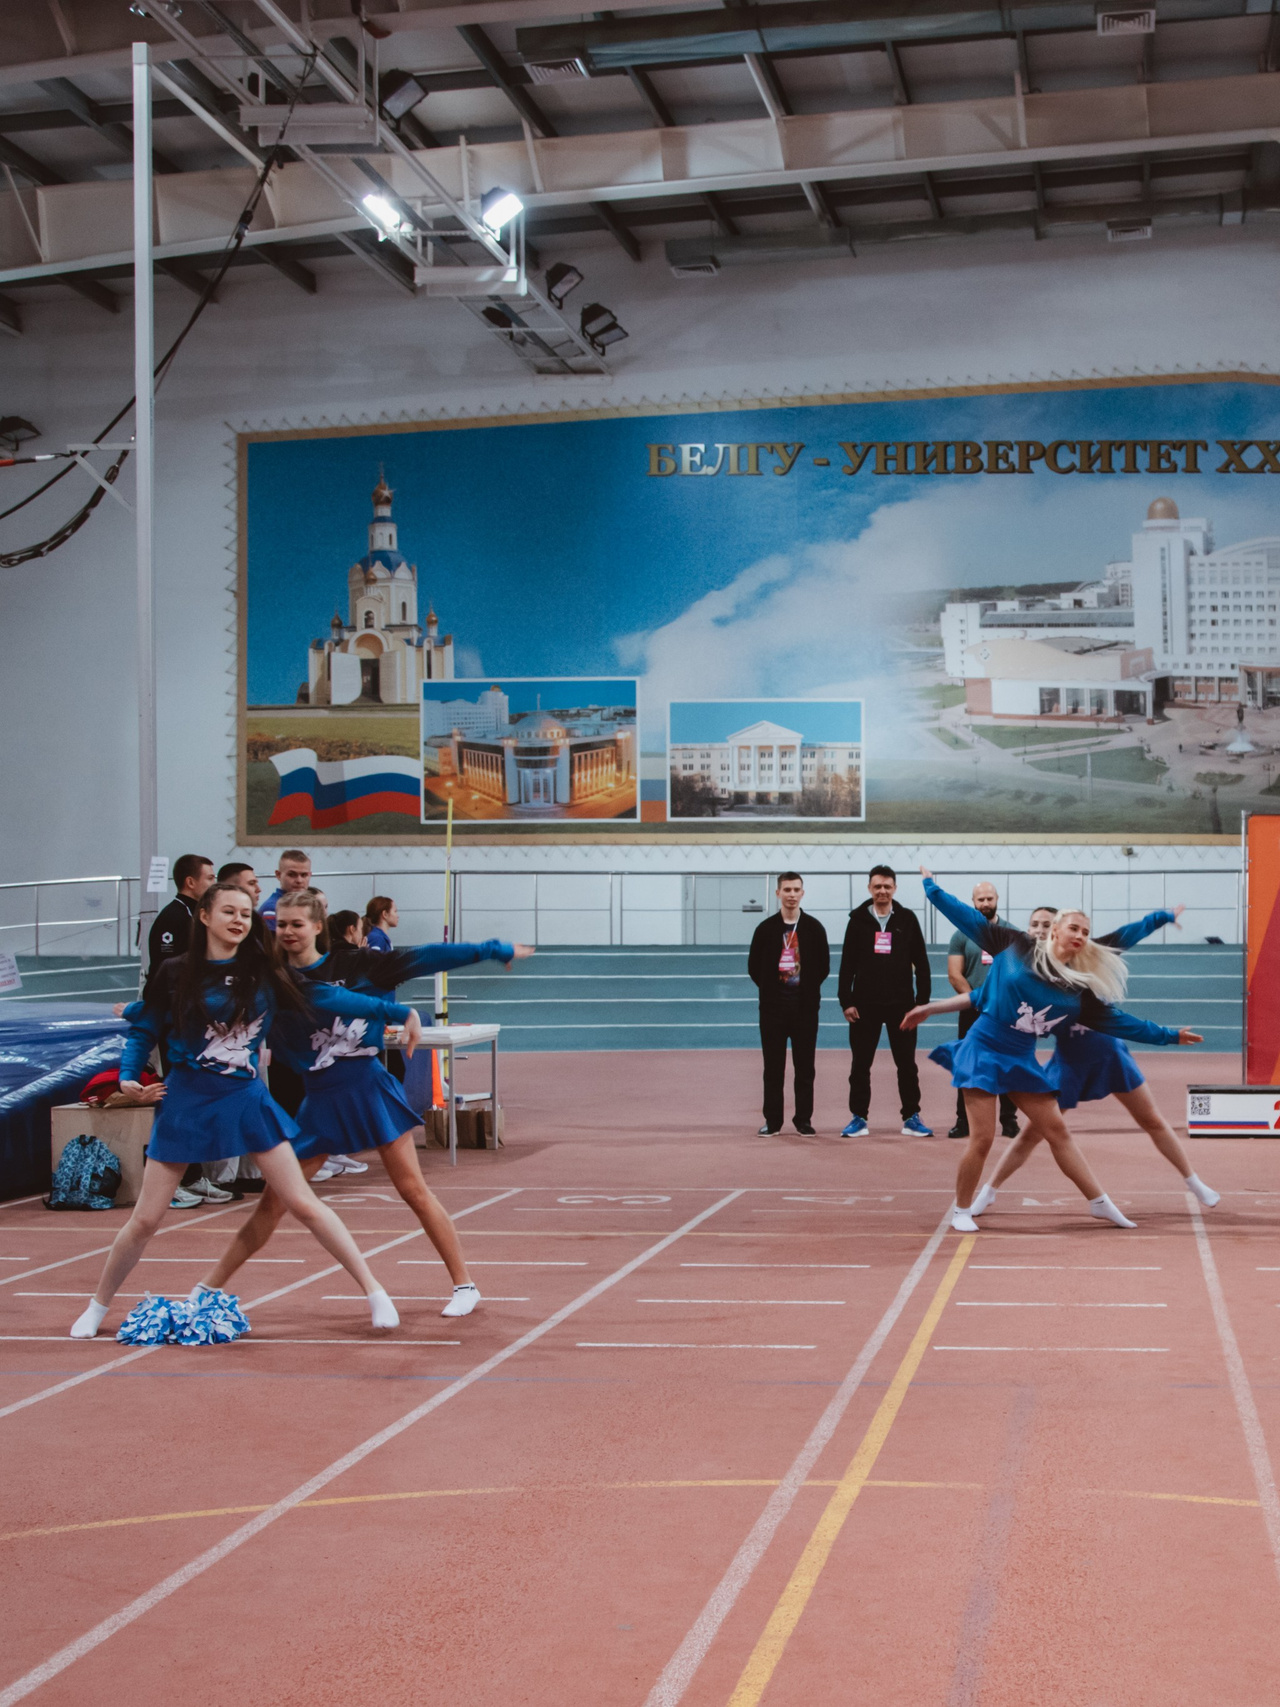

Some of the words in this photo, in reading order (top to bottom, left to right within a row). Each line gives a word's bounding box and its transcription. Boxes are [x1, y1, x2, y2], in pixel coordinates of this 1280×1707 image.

[646, 442, 804, 477] БЕЛГУ
[840, 440, 1208, 475] УНИВЕРСИТЕТ
[556, 1194, 672, 1205] 3
